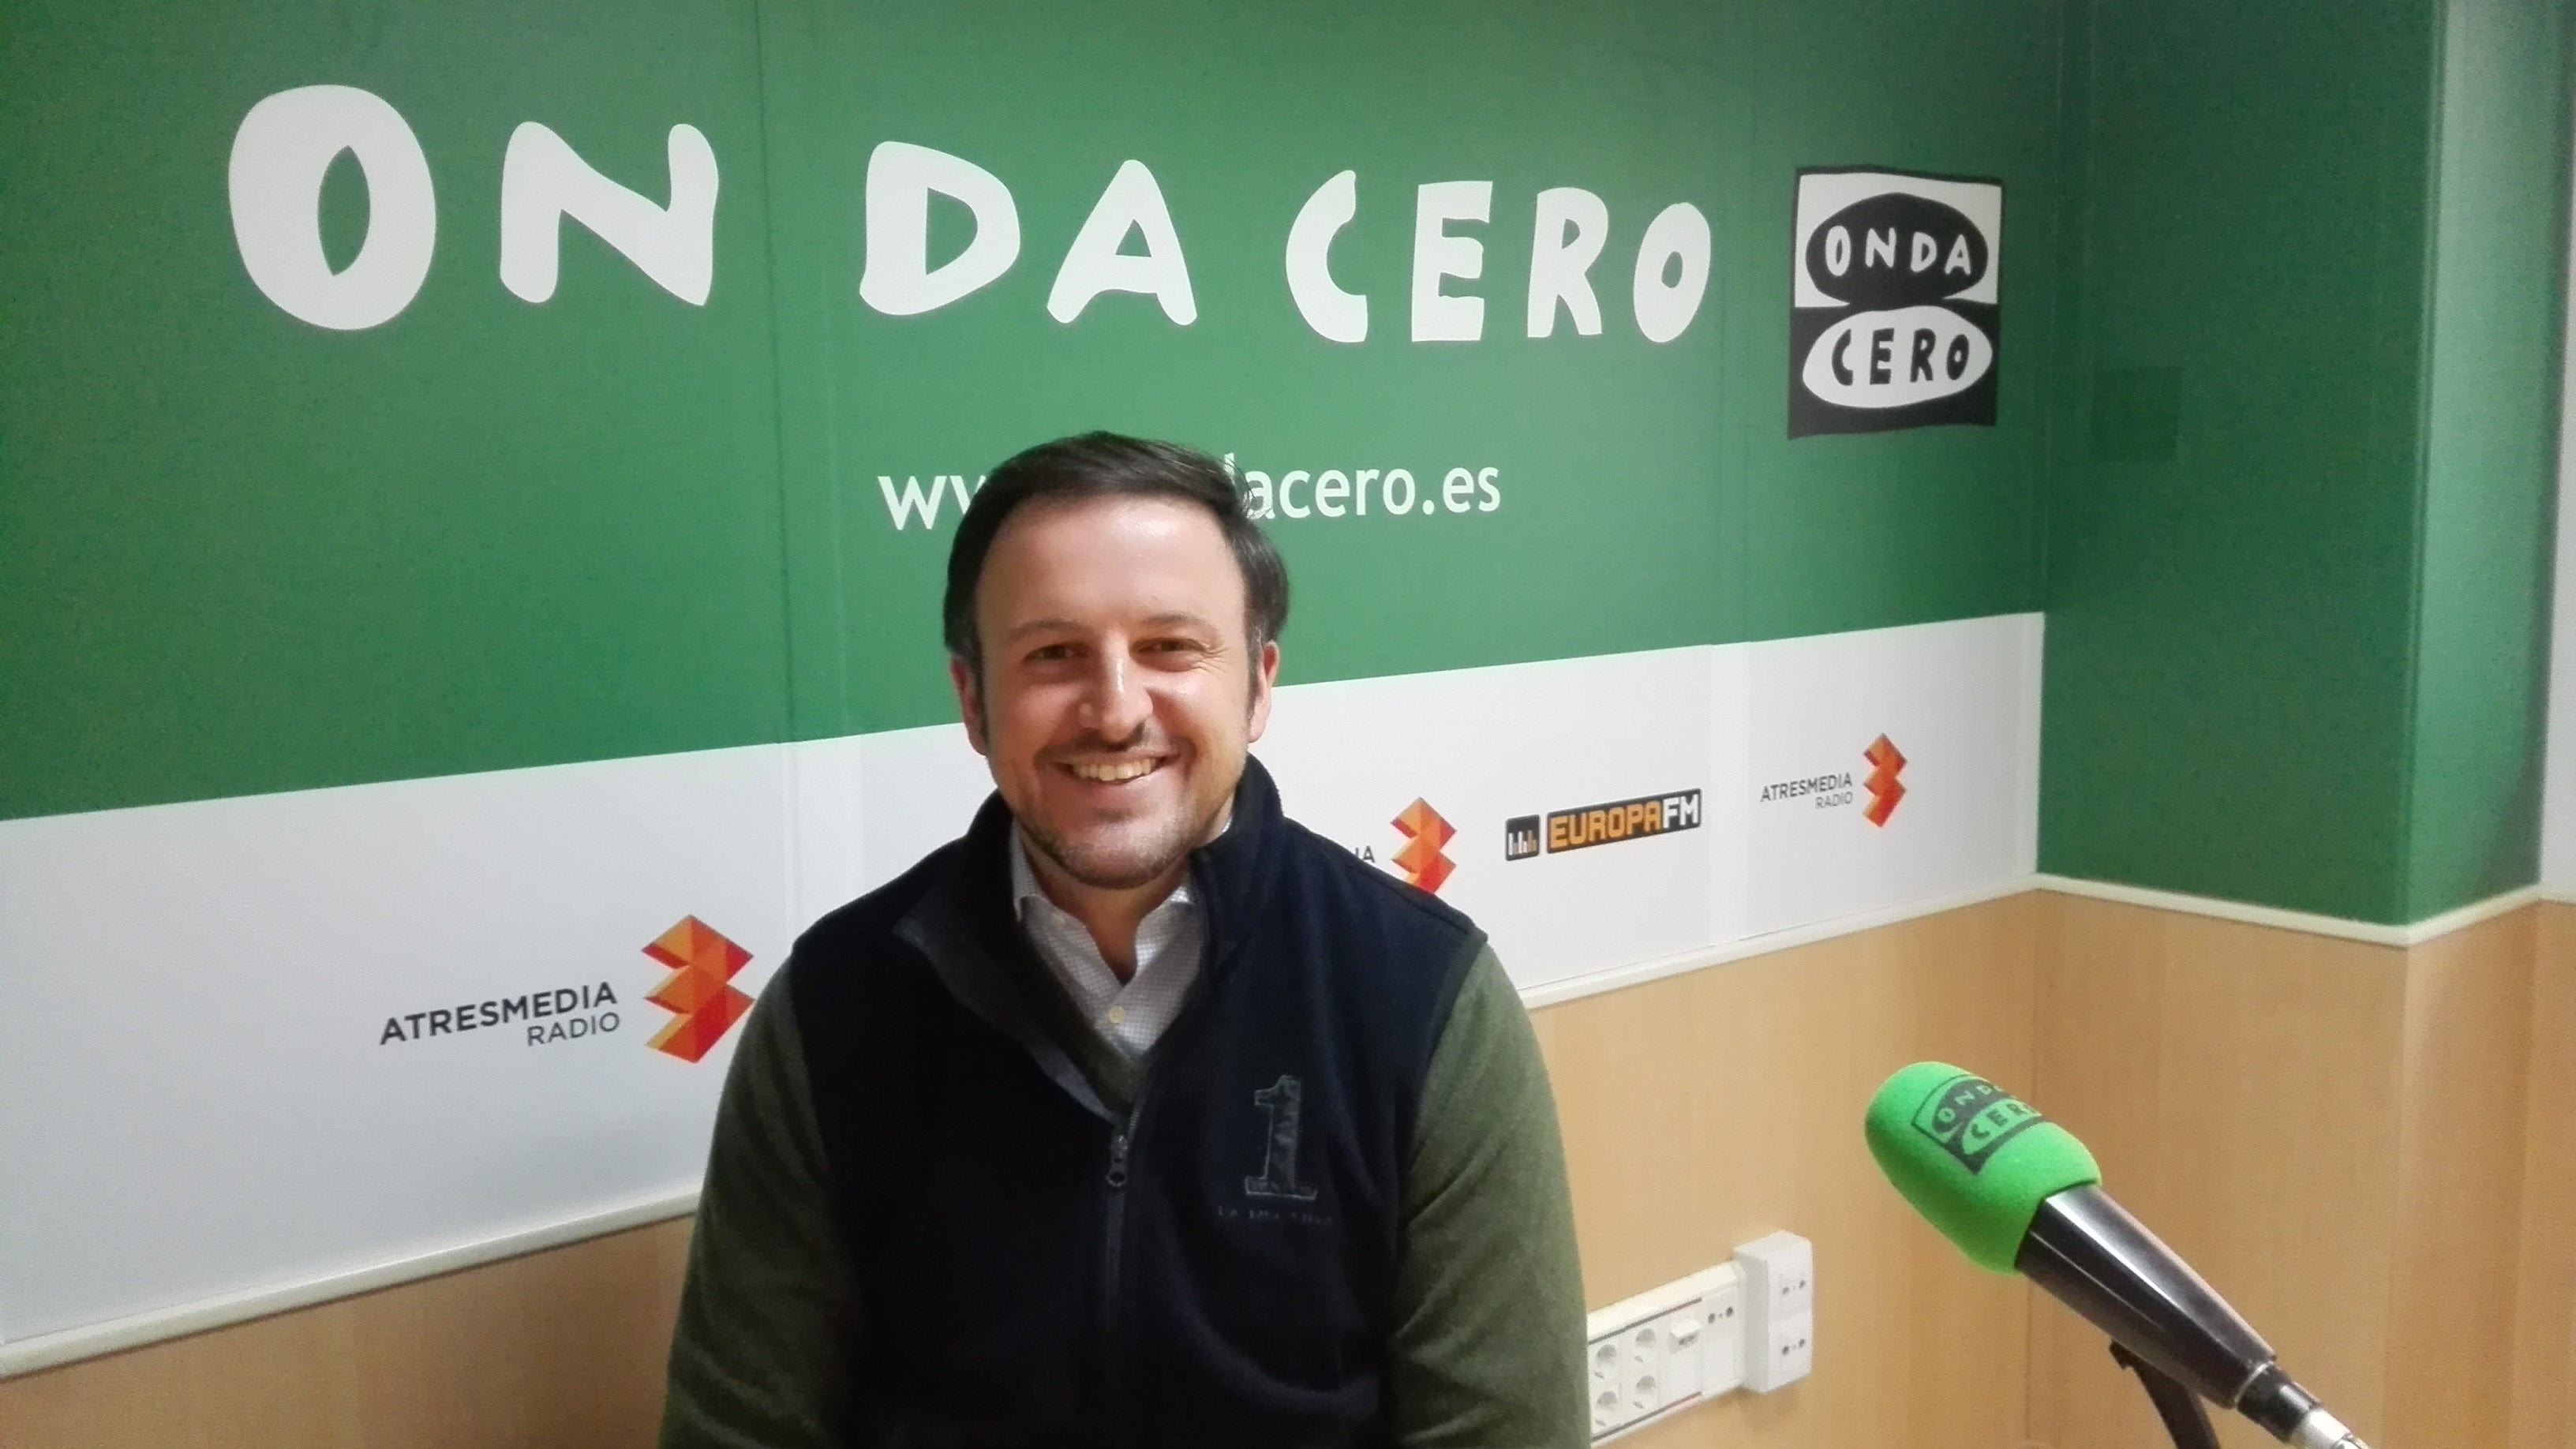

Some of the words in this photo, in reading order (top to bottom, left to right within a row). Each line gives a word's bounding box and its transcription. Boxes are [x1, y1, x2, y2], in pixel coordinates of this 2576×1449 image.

[1286, 170, 1711, 343] CERO
[1825, 225, 1971, 276] ONDA
[1832, 328, 1970, 386] CERO
[1759, 771, 1852, 803] ATRESMEDIA
[1815, 791, 1853, 810] RADIO
[380, 981, 619, 1046] ATRESMEDIA
[527, 1011, 620, 1047] RADIO
[1938, 1084, 2005, 1123] OND
[1971, 1103, 2038, 1139] CER
